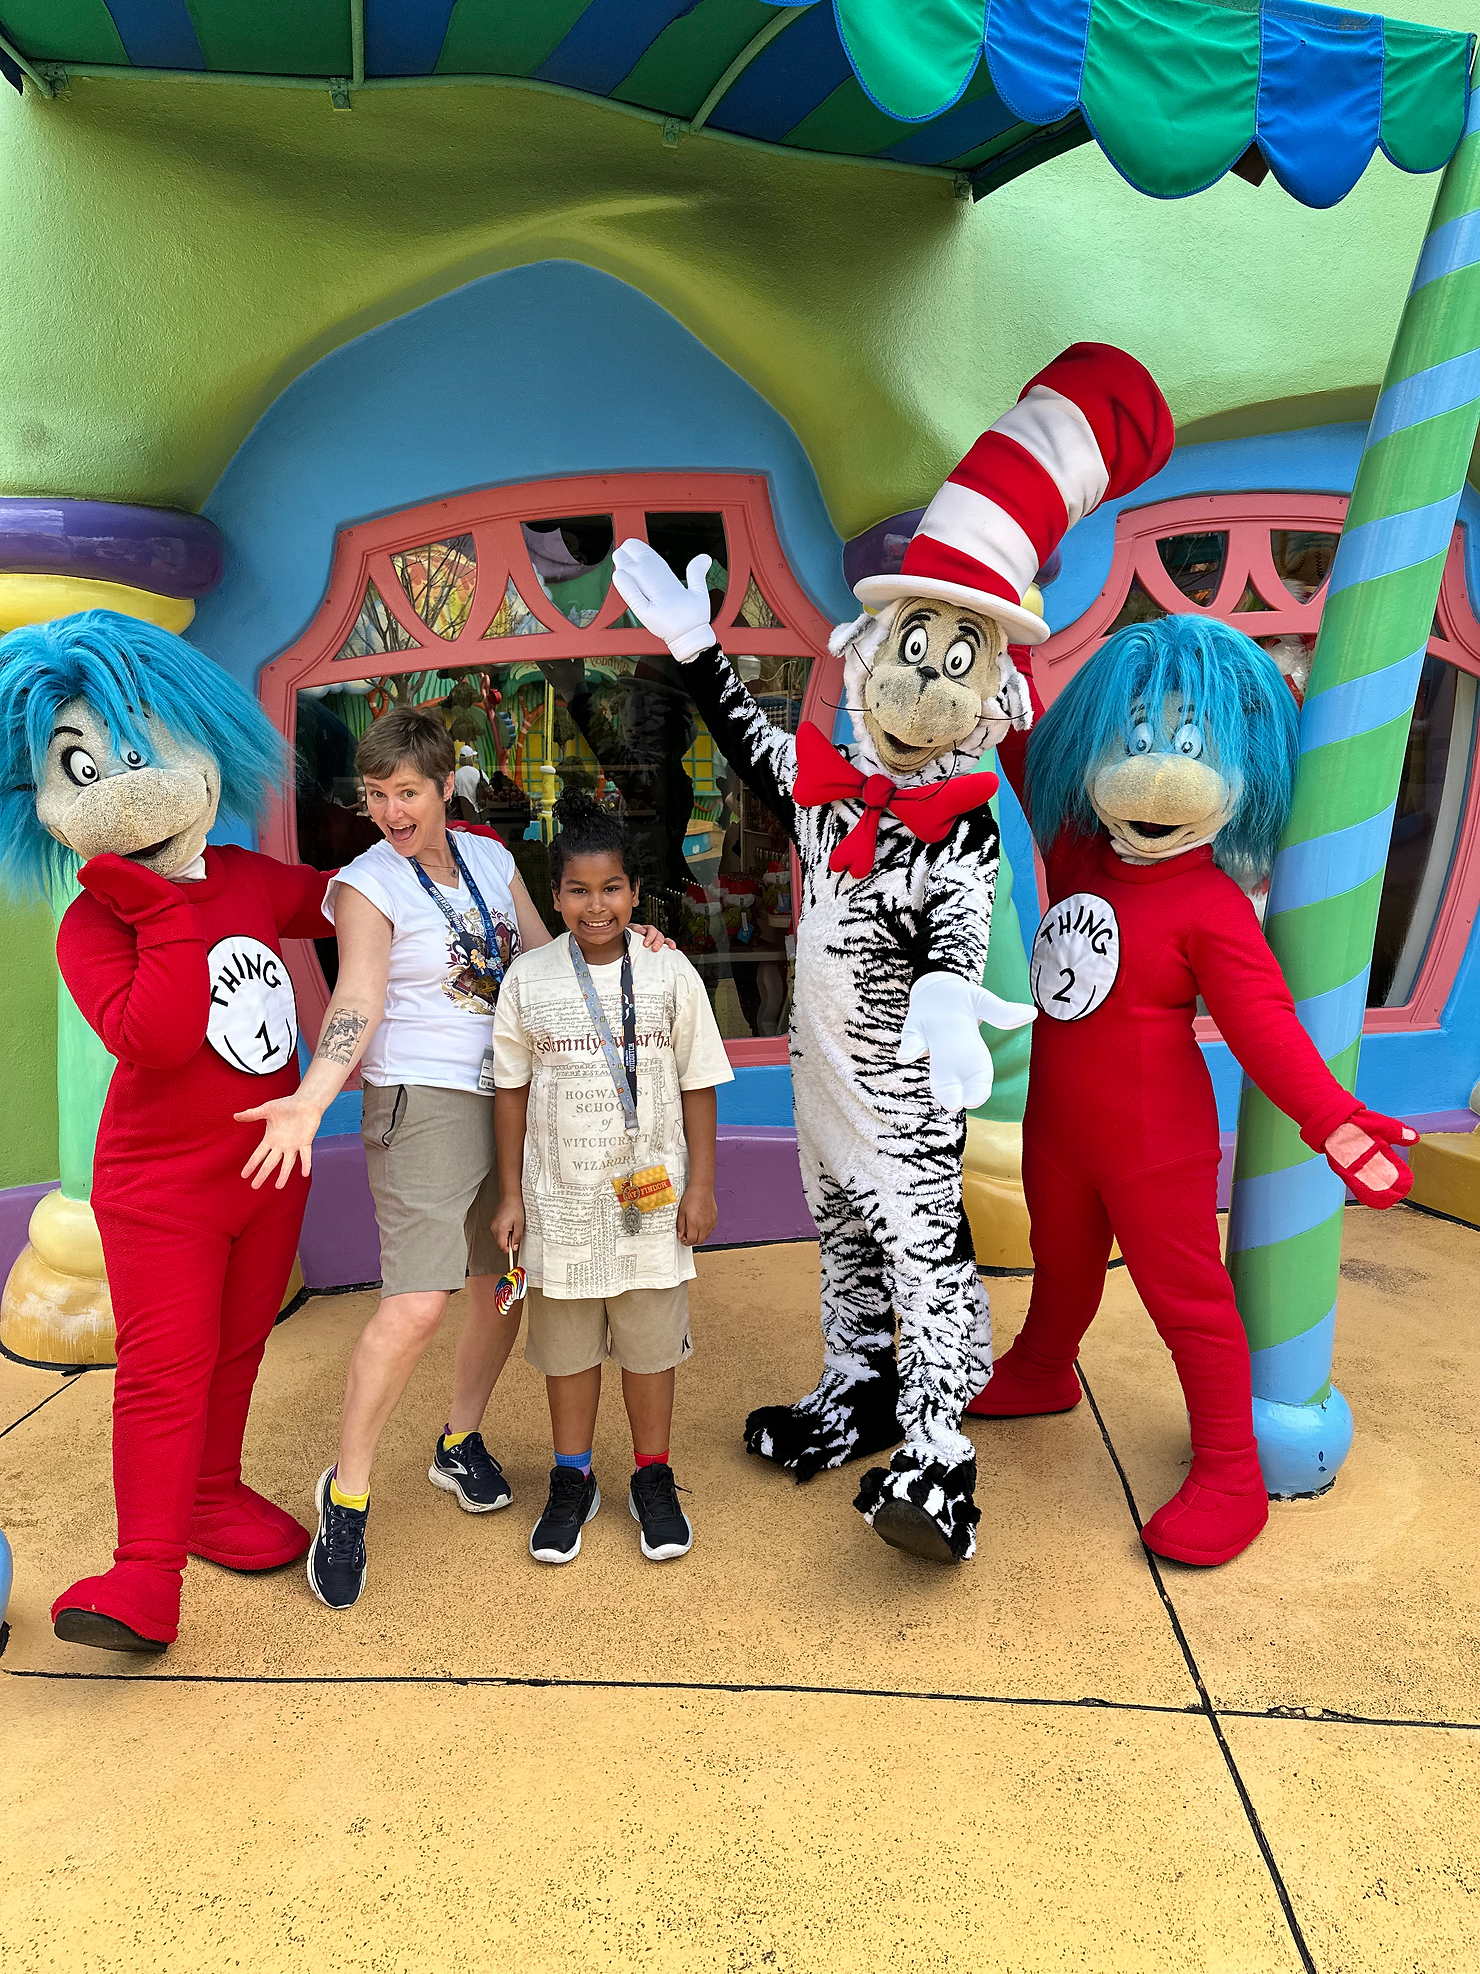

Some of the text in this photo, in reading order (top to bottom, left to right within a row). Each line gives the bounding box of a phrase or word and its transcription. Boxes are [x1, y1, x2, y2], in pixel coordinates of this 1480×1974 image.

[1040, 905, 1113, 956] THING
[211, 953, 282, 1007] THING
[1052, 968, 1075, 1003] 2
[254, 1020, 280, 1063] 1
[565, 1087, 643, 1100] HOGWAS
[576, 1102, 626, 1113] SCHOO
[598, 1118, 613, 1131] of
[604, 1150, 612, 1158] &
